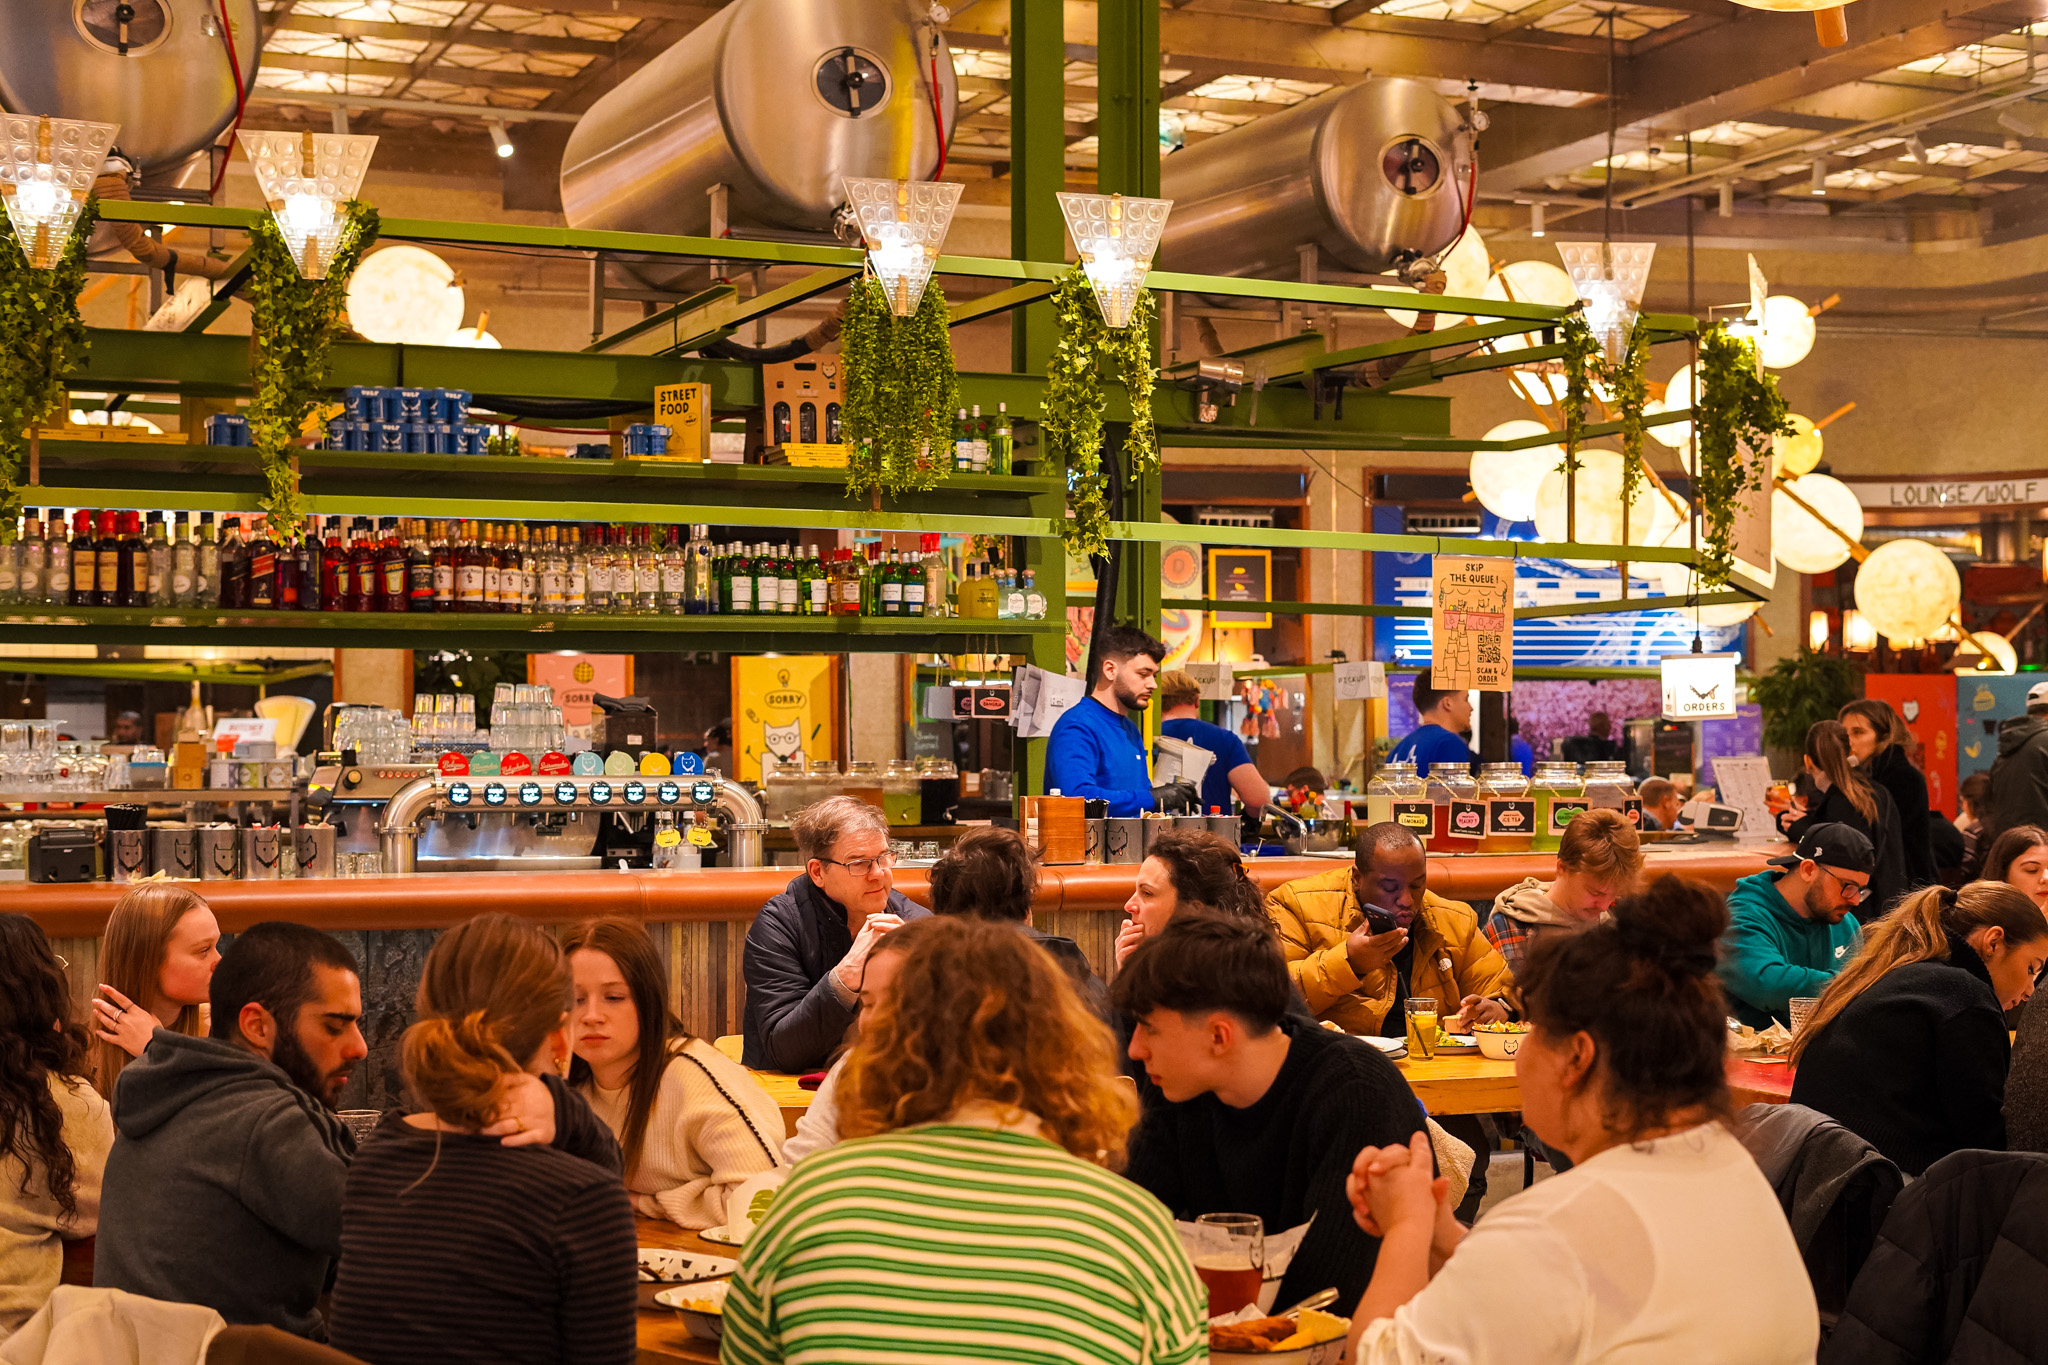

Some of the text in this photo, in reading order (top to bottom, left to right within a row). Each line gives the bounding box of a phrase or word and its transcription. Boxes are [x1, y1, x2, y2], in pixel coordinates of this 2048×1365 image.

[659, 387, 697, 403] STREET
[660, 402, 690, 416] FOOD
[1449, 573, 1467, 583] THE
[1468, 574, 1495, 584] QUEUE
[1337, 674, 1367, 685] PICKUP
[1477, 675, 1498, 683] ORDER
[769, 694, 802, 704] SORRY
[1683, 702, 1726, 712] ORDERS
